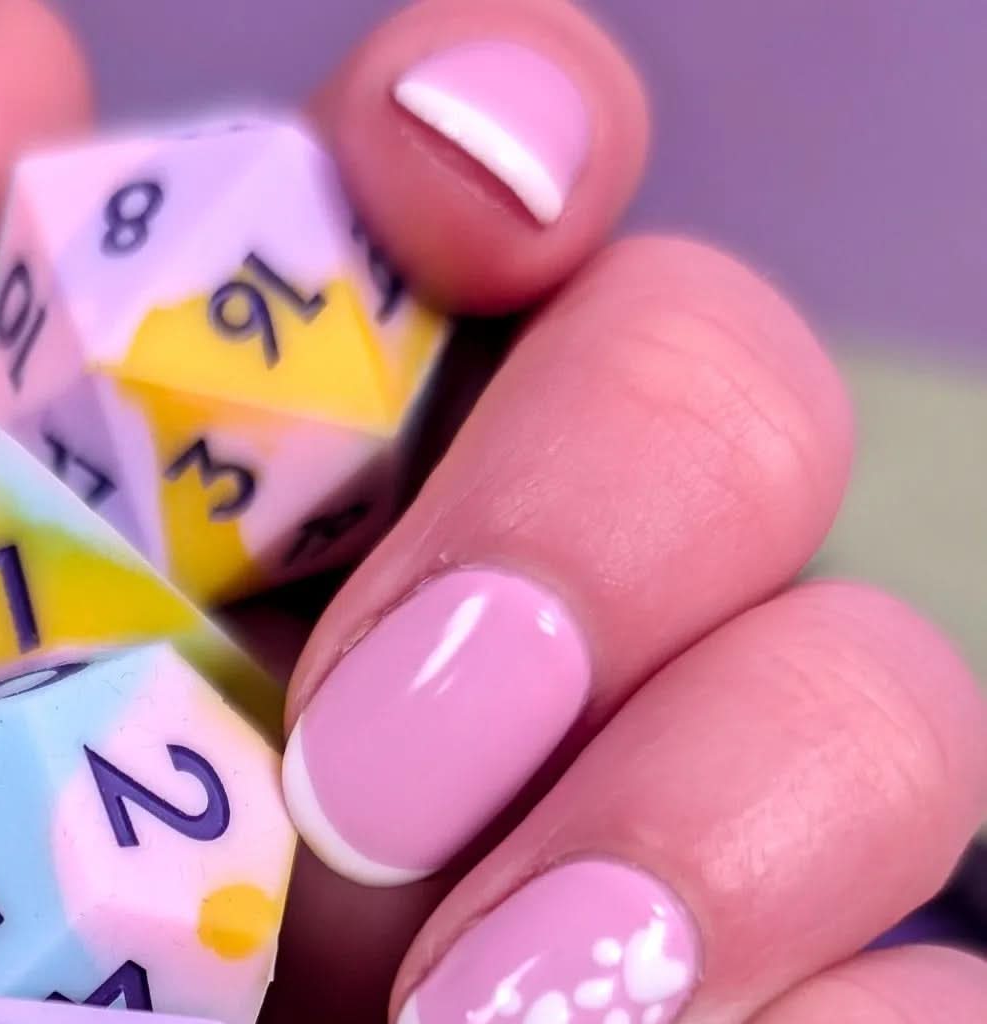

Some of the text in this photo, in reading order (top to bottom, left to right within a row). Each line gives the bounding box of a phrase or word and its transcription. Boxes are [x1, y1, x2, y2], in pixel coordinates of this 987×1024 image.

[101, 180, 164, 256] 8
[207, 251, 328, 372] 16
[164, 437, 258, 523] 3
[83, 743, 231, 848] 2
